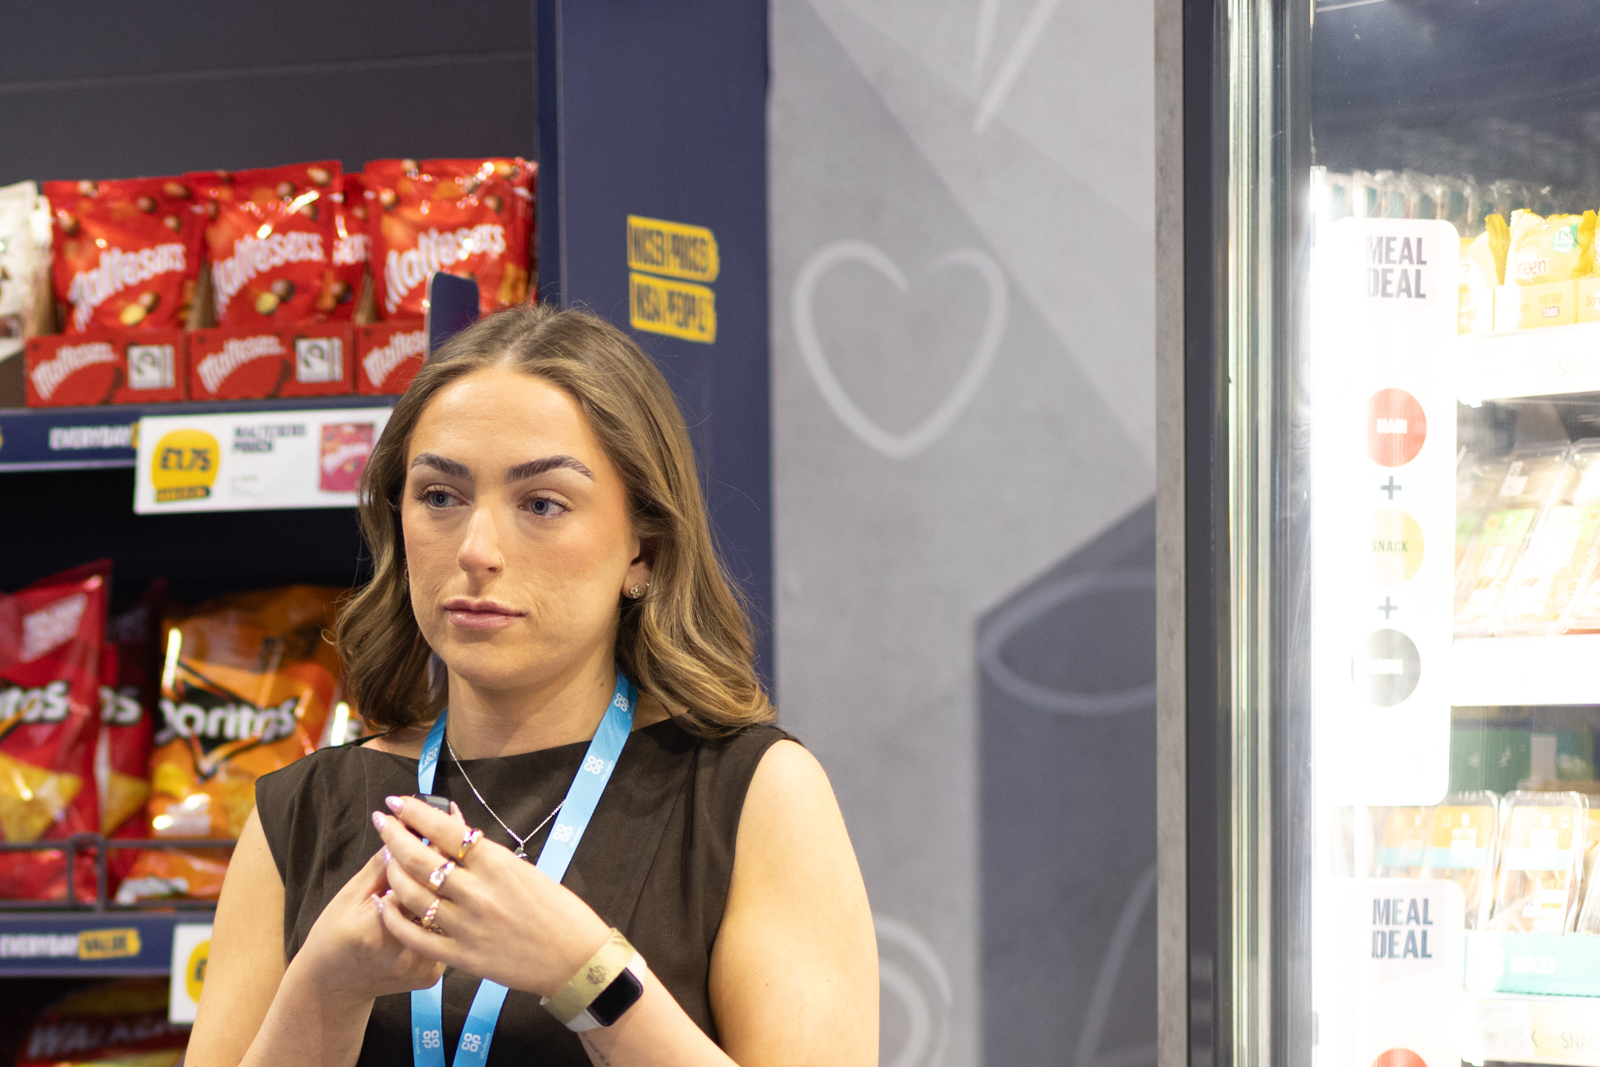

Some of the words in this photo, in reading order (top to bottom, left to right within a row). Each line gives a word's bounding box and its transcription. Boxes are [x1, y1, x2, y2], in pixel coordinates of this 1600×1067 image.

[1365, 236, 1427, 265] MEAL
[1364, 267, 1426, 299] DEAL
[1372, 898, 1433, 926] MEAL
[1371, 929, 1432, 960] DEAL
